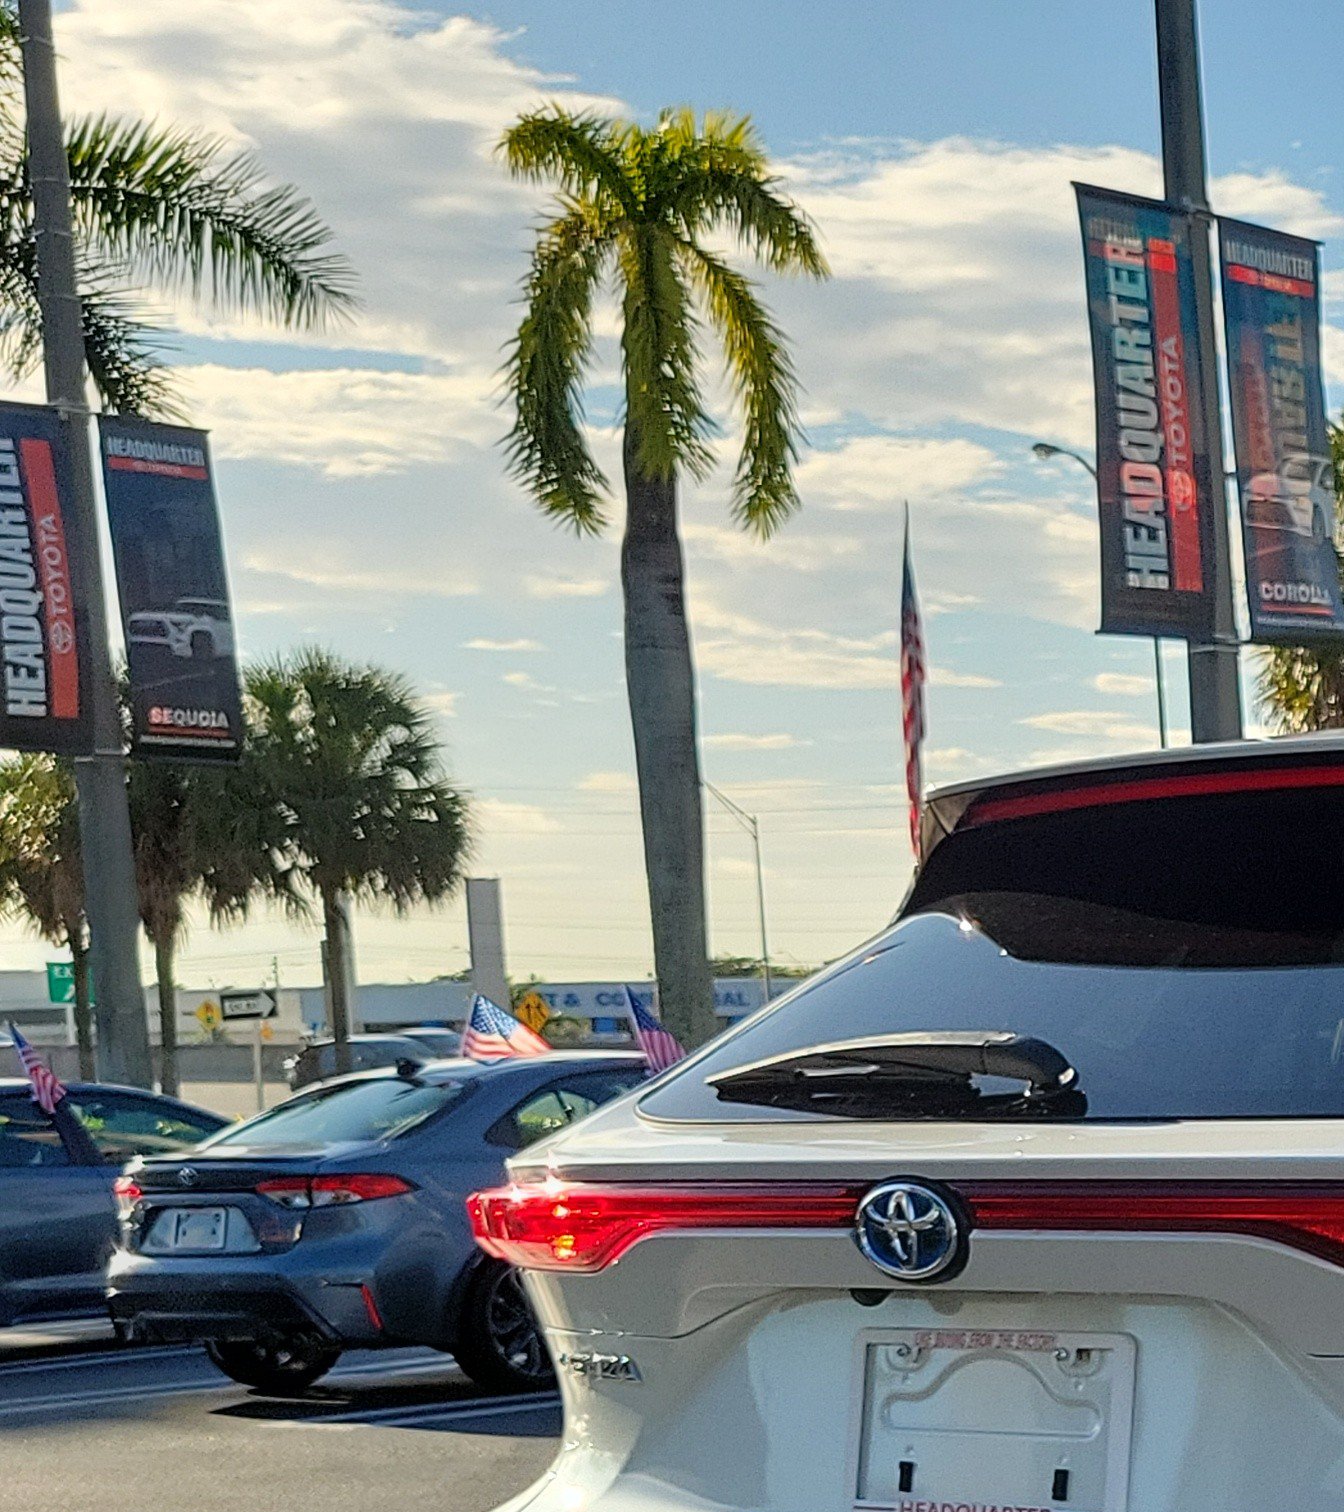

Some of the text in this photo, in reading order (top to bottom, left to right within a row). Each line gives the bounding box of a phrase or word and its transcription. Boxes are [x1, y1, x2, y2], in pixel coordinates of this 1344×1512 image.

[1223, 240, 1314, 283] HEADQUARTER
[1105, 239, 1170, 590] HEADQUARTER
[1161, 335, 1188, 466] TOYOTA
[106, 436, 205, 468] HEADQUARTER
[40, 513, 68, 616] TOYOTA
[148, 706, 229, 729] SEQUOIA
